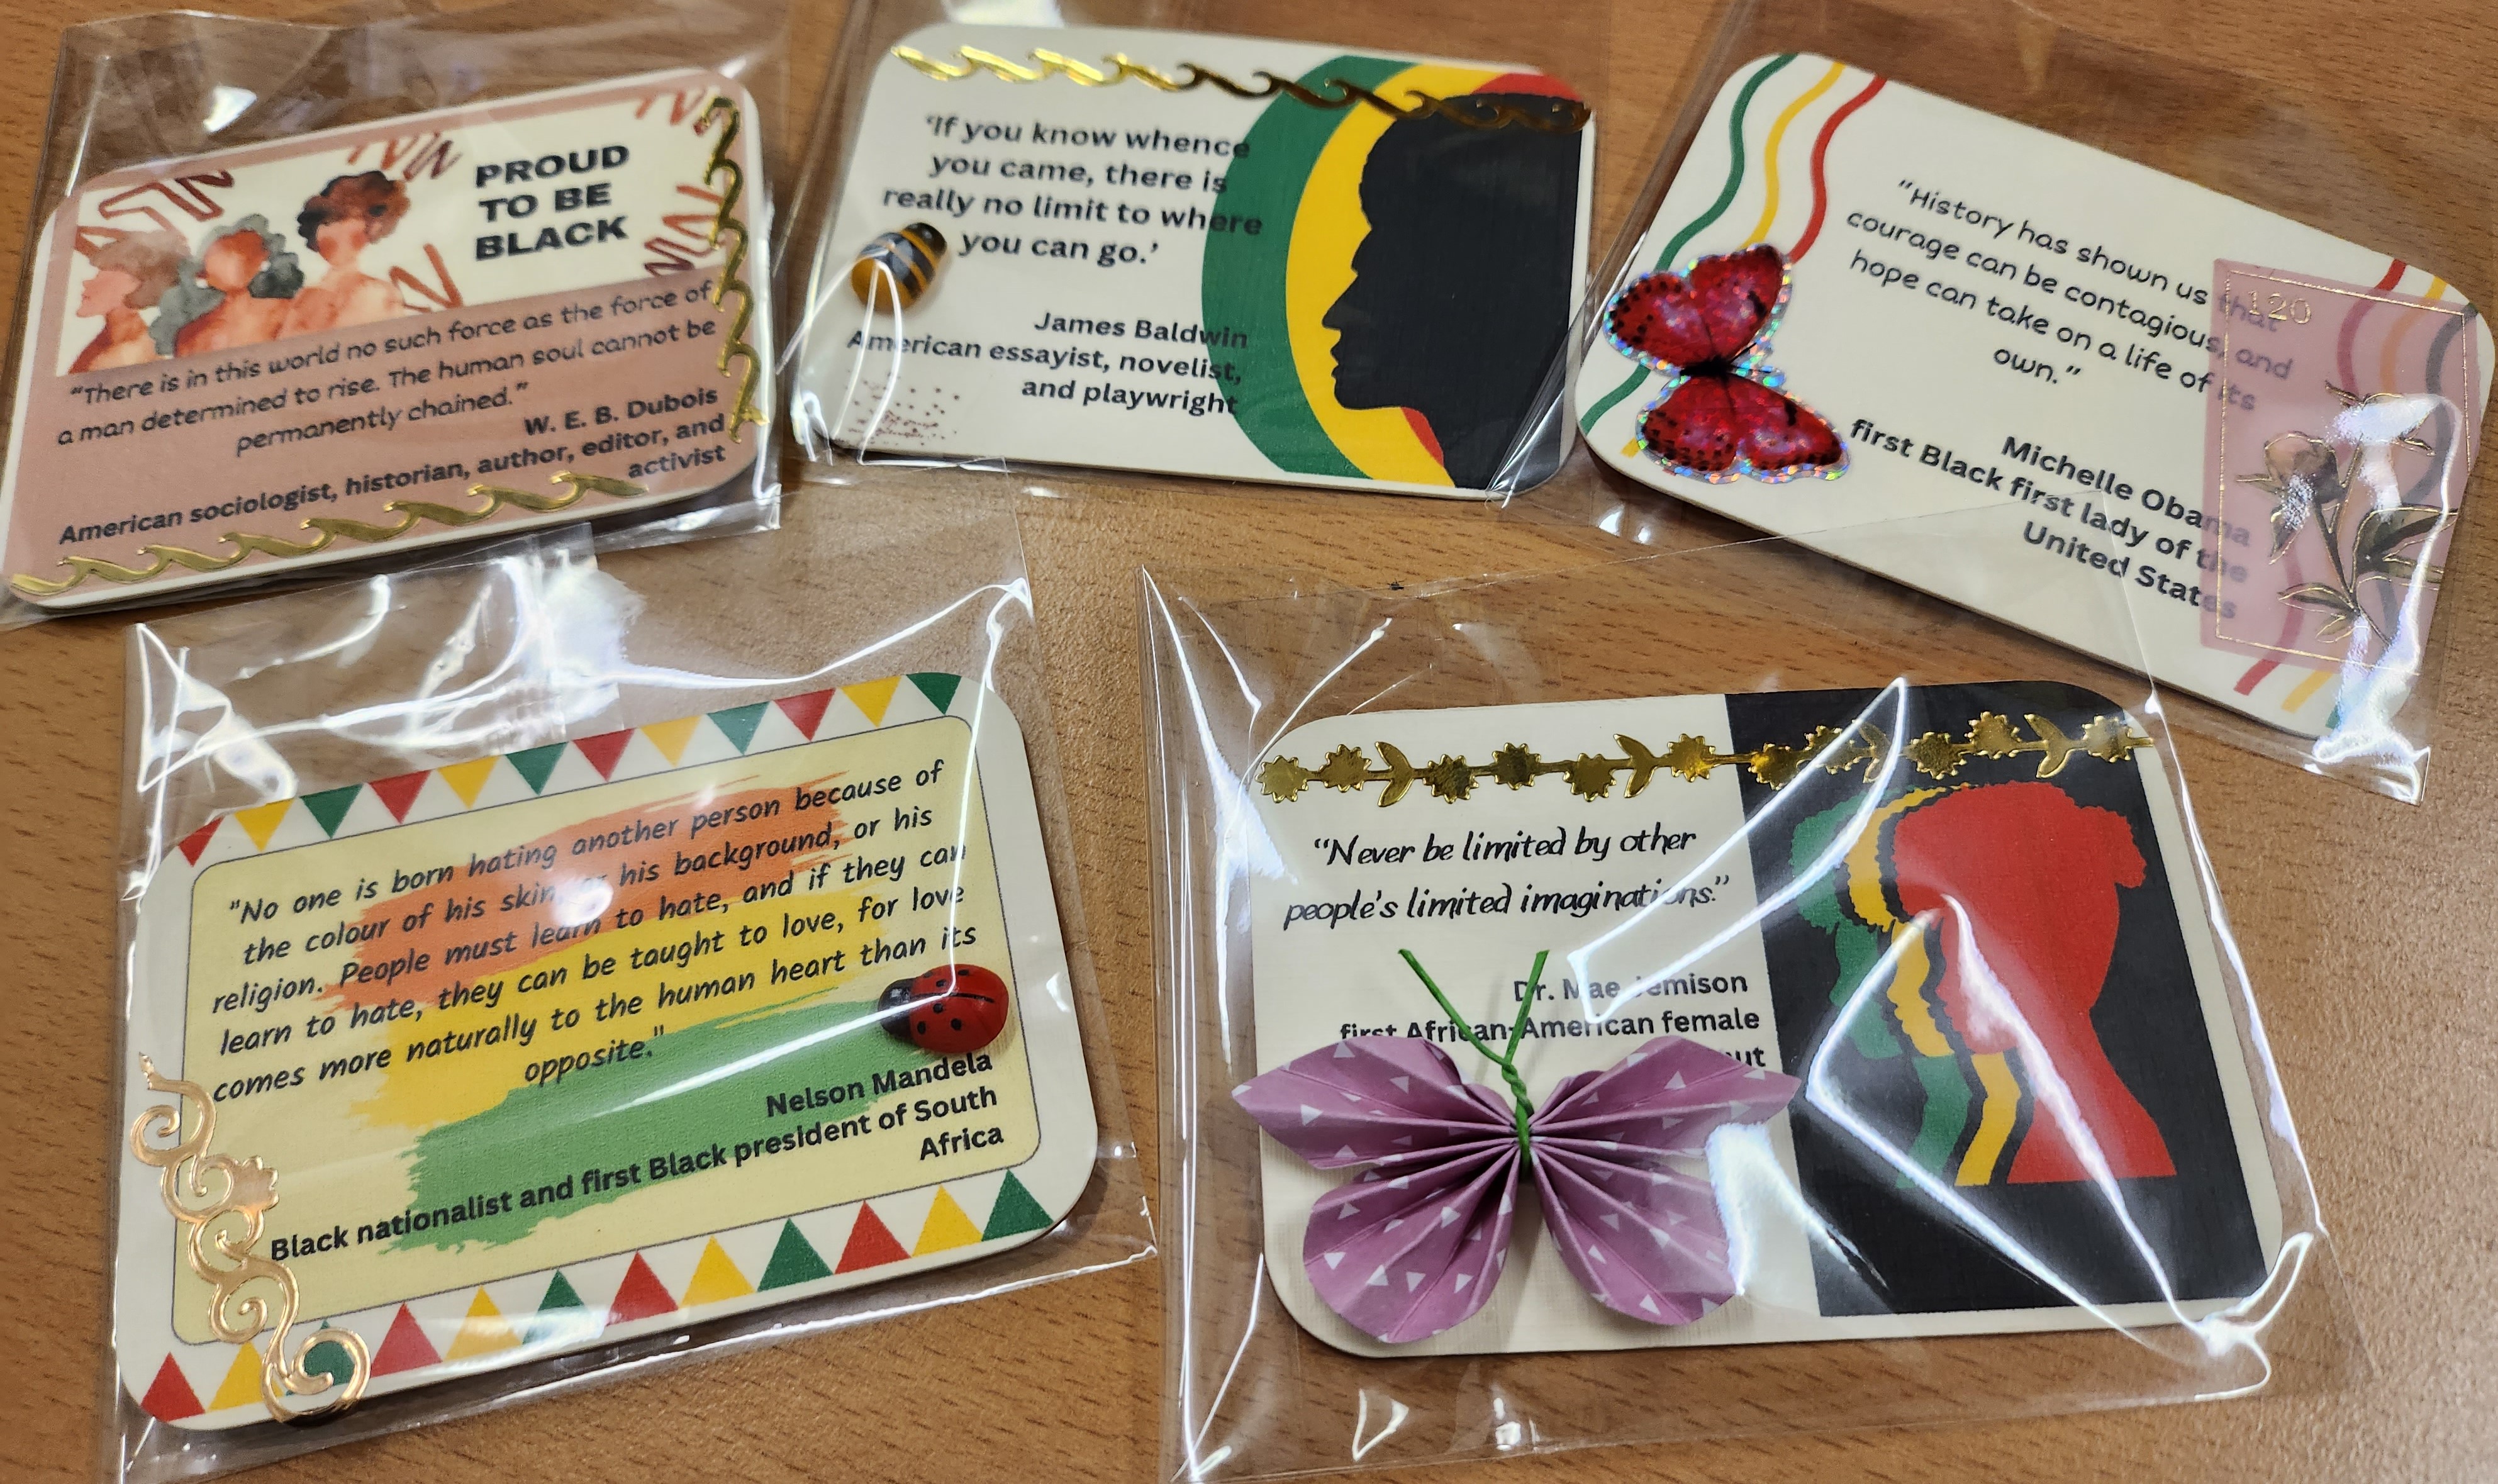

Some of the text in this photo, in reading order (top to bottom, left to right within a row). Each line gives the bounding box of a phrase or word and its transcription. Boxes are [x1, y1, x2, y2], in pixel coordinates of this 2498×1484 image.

[475, 145, 630, 189] PROUD
[961, 122, 1022, 144] you
[1032, 121, 1117, 147] know
[1125, 128, 1249, 157] whence
[928, 155, 1226, 192] you came, there is
[477, 182, 611, 223] TO BE
[883, 187, 1262, 235] really no limit to where
[475, 215, 628, 261] BLACK
[958, 233, 1159, 268] you can go.’
[1899, 179, 2015, 239] “History
[2017, 220, 2069, 255] has
[2076, 245, 2168, 291] shown
[2176, 282, 2208, 305] us
[1846, 212, 1960, 260] courage
[1966, 252, 2017, 280] can
[2023, 264, 2058, 294] be
[2235, 347, 2294, 379] and
[1850, 248, 1920, 289] hope
[1926, 281, 1977, 310] can
[1987, 296, 2049, 335] take
[2056, 326, 2092, 350] on
[2098, 342, 2117, 360] a
[2124, 343, 2172, 380] life
[2179, 369, 2214, 394] of
[2248, 289, 2312, 325] 120
[70, 280, 718, 404] “There is in this world no such force as the force of
[845, 329, 1241, 385] American essayist, novelist,
[1034, 311, 1247, 348] James Baldwin
[57, 320, 715, 445] a man determined to rise. The human soul cannot be
[1021, 379, 1239, 419] and playwright
[237, 381, 528, 457] permanently chained.”
[523, 388, 718, 436] W. E. B. Dubois
[59, 413, 725, 545] American sociologist, historian, author, editor, and
[628, 445, 725, 478] activist
[1849, 418, 2248, 586] first Black first lady of the
[2000, 436, 2250, 546] Michelle Obama
[2023, 520, 2236, 619] United States
[293, 889, 342, 913] one
[355, 878, 378, 901] is
[391, 866, 454, 893] born
[468, 845, 557, 878] hating
[572, 820, 679, 855] another
[691, 800, 780, 840] person
[794, 775, 902, 811] because
[915, 759, 944, 786] of
[1314, 822, 1697, 866] “Never be limited by other
[243, 936, 291, 966] the
[304, 918, 391, 952] colour
[401, 902, 434, 932] of
[444, 896, 486, 923] his
[620, 860, 660, 887] his
[674, 820, 840, 876] background,
[853, 818, 881, 840] or
[893, 805, 933, 832] his
[1406, 882, 1513, 920] limited
[213, 973, 324, 1014] religion.
[340, 951, 431, 988] People
[444, 932, 519, 966] must
[531, 917, 601, 949] learn
[615, 908, 645, 929] to
[659, 892, 730, 922] hate,
[742, 875, 795, 905] and
[808, 862, 830, 890] if
[842, 856, 905, 886] they
[220, 886, 966, 1056] learn to hate, they can be taught to love, for love
[1635, 972, 1748, 999] emison
[213, 927, 976, 1103] comes more naturally to the human heart than its
[1661, 1007, 1760, 1034] female
[766, 1052, 993, 1118] Nelson Mandela
[920, 1127, 1005, 1161] Africa
[270, 1085, 997, 1262] Black nationalist and first Black president of South
